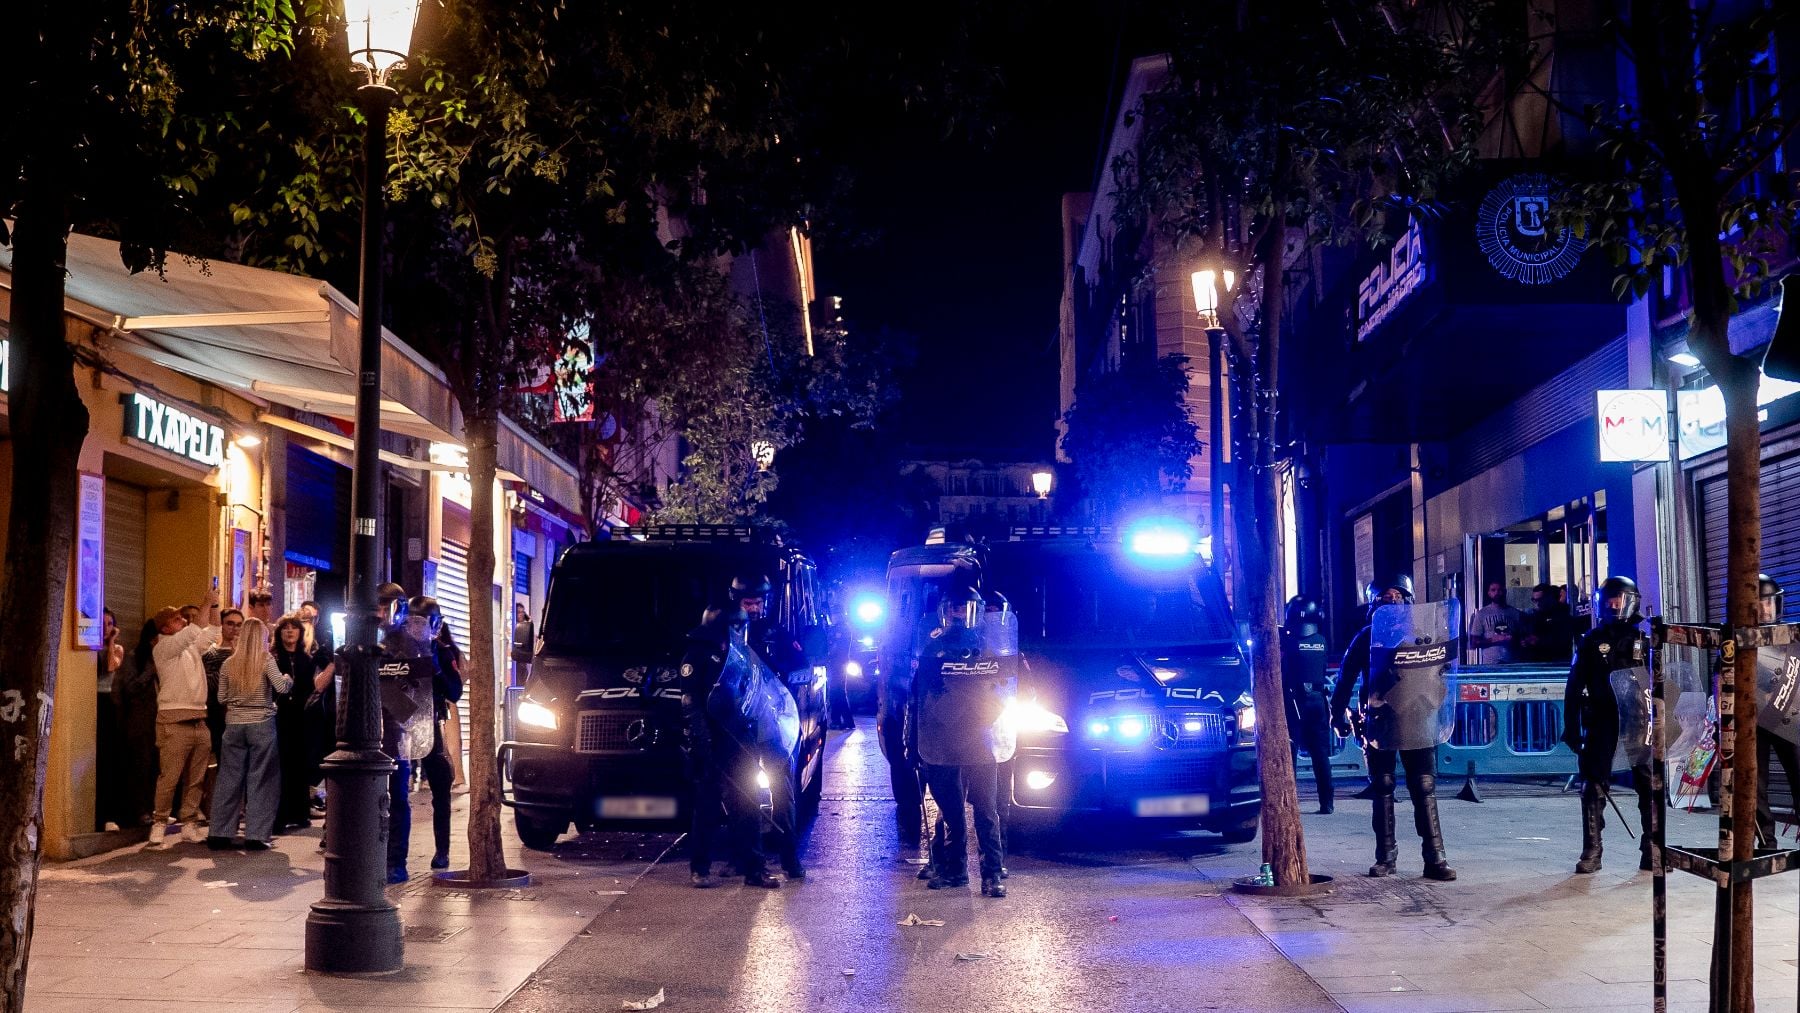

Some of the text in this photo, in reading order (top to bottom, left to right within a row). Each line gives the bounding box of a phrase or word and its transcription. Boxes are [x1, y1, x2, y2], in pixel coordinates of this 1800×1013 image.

[1508, 244, 1561, 262] MUNICIPAL
[134, 392, 225, 466] TXAPELA
[575, 687, 682, 702] POLIC
